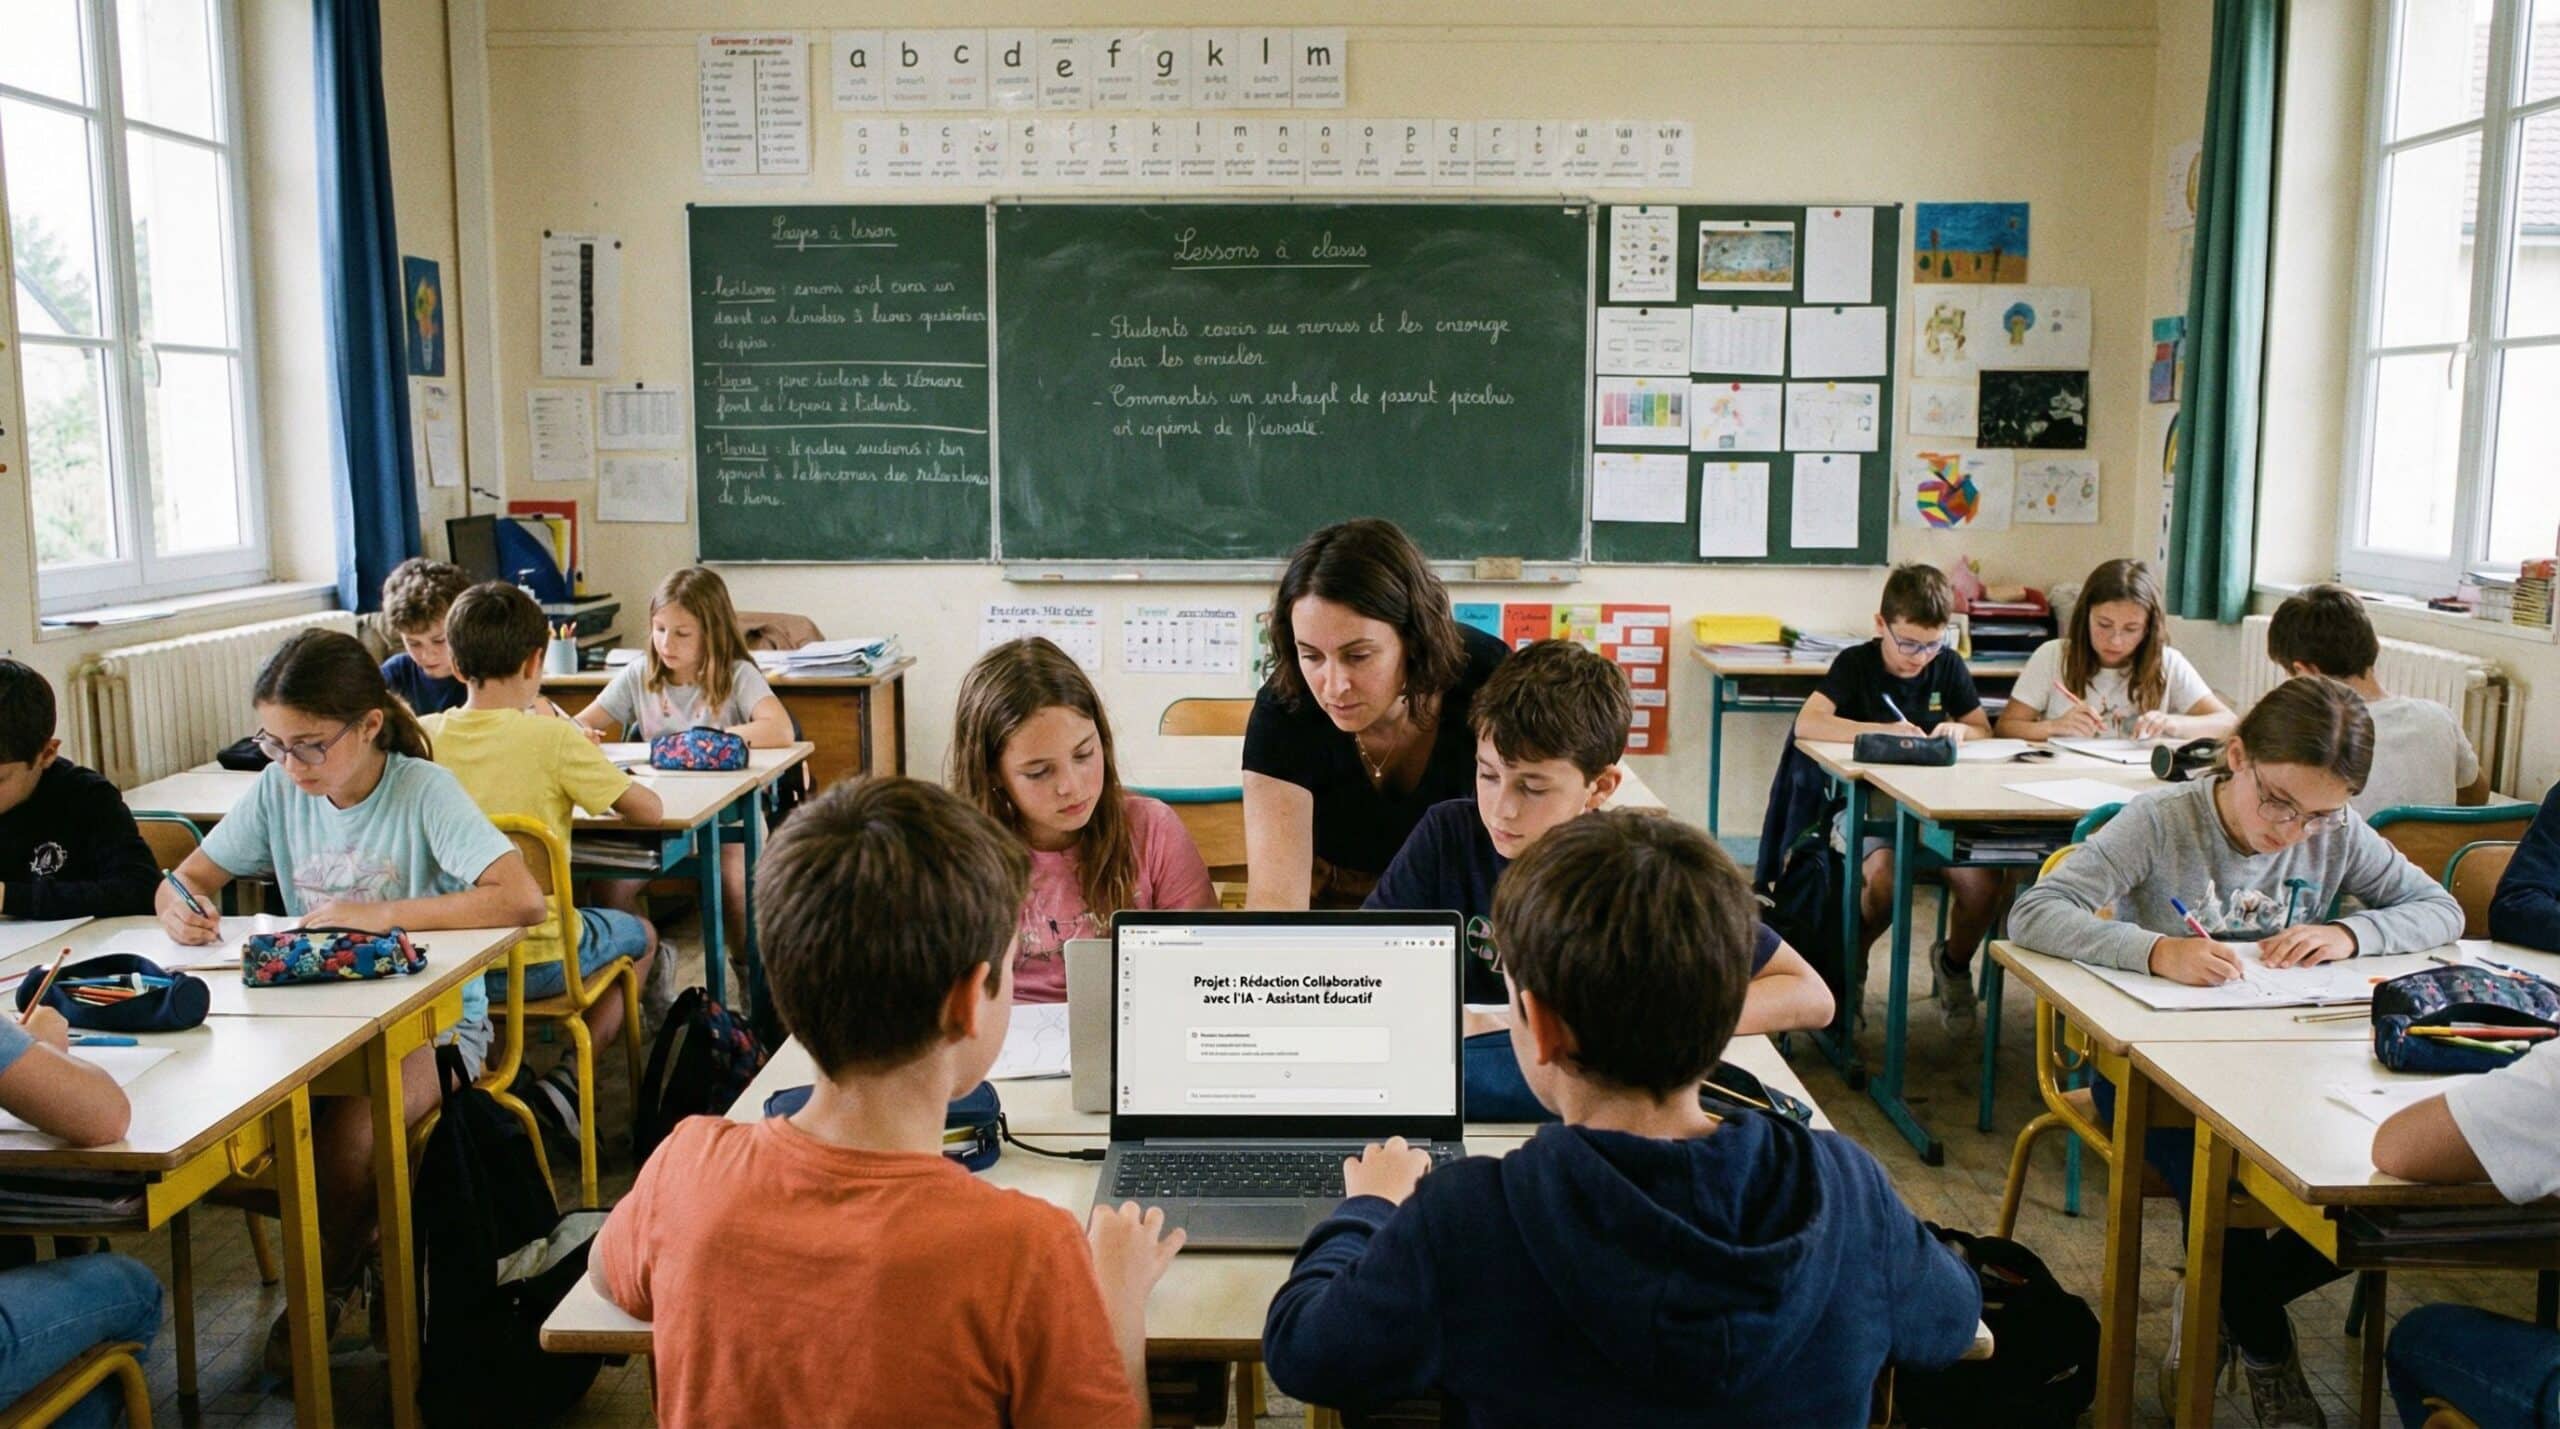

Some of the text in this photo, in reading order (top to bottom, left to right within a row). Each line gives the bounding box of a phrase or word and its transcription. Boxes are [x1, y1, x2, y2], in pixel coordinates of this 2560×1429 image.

[850, 48, 867, 68] a
[902, 41, 918, 67] b
[954, 45, 969, 64] c
[1004, 41, 1021, 67] d
[1057, 58, 1073, 77] e
[1107, 39, 1121, 68] f
[1157, 49, 1173, 77] g
[1208, 39, 1223, 66] k
[1307, 45, 1330, 66] m
[900, 123, 909, 137] b
[1152, 121, 1160, 136] k
[1234, 126, 1247, 136] m
[1279, 126, 1288, 136] n
[1406, 127, 1416, 140] p
[1173, 227, 1259, 260] Lessons
[1110, 315, 1189, 339] Students
[1397, 309, 1424, 334] les
[1350, 383, 1369, 405] de
[1214, 416, 1233, 435] de
[1194, 976, 1230, 991] Projet
[1240, 976, 1299, 988] Rédaction
[1303, 976, 1382, 988] Collaborative
[1203, 994, 1230, 1004] avec
[1234, 992, 1254, 1004] l'IA
[1266, 992, 1320, 1004] Assistant
[1324, 990, 1373, 1004] Éducatif
